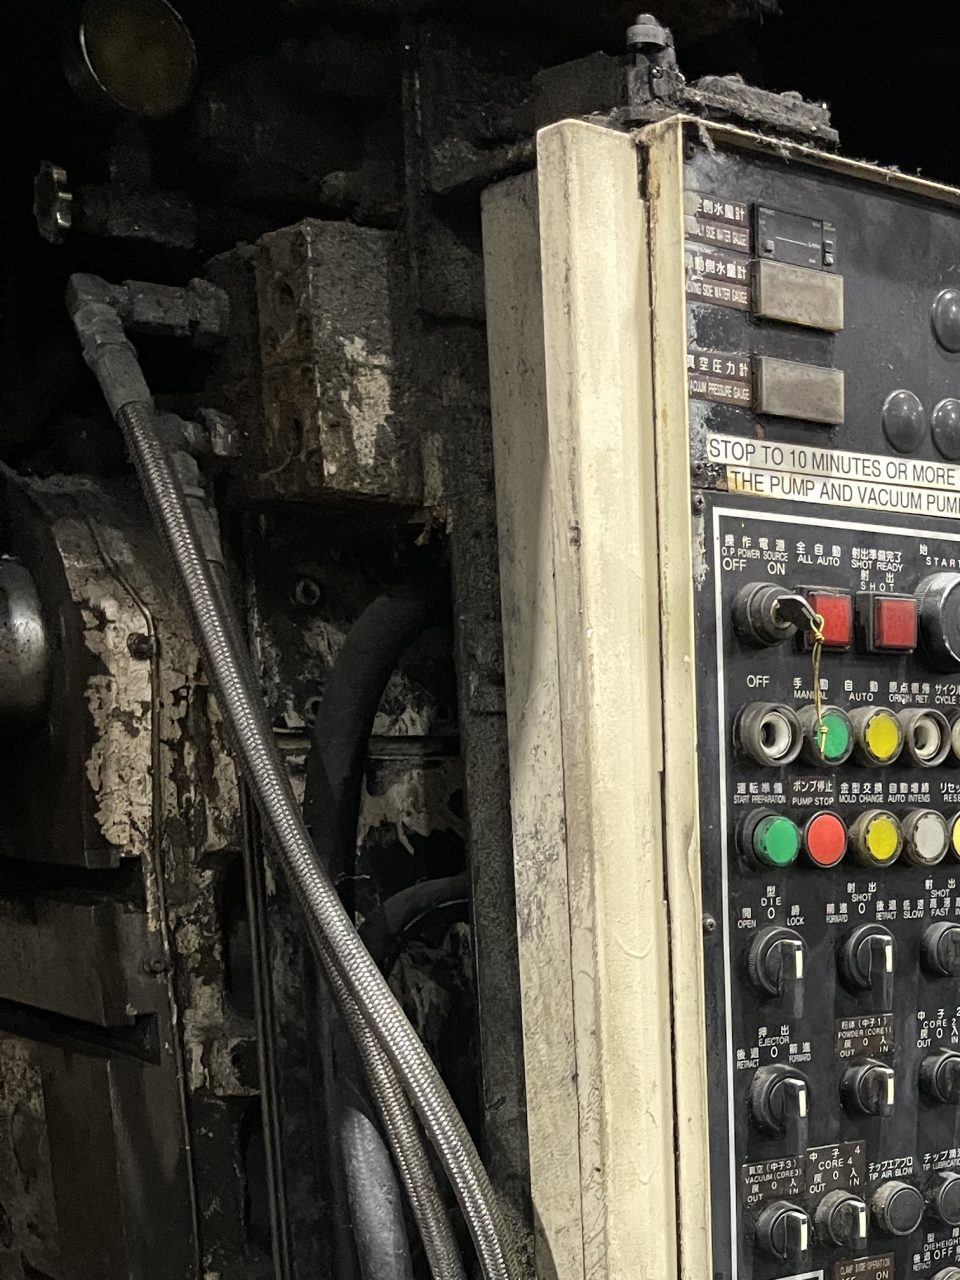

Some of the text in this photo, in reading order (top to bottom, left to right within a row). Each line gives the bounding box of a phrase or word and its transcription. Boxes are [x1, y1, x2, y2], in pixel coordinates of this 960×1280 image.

[709, 438, 756, 461] STOP
[761, 445, 783, 465] TO
[790, 450, 807, 469] 10
[811, 452, 882, 478] MINUTES
[886, 462, 907, 480] OR
[912, 465, 956, 486] MORE
[730, 471, 765, 492] THE
[770, 476, 815, 499] PUMP
[820, 482, 852, 502] AND
[857, 486, 922, 510] VACUUM
[738, 549, 788, 562] POWER SOURCE
[797, 554, 840, 566] ALL AUTO
[722, 557, 747, 571] OFF
[767, 561, 786, 575] ON
[851, 560, 903, 572] SHOT READY
[860, 581, 895, 592] SHOT
[746, 674, 770, 688] OFF
[793, 690, 828, 700] MANAL
[848, 692, 874, 702] AUTO
[935, 695, 956, 704] CYCLE
[792, 797, 835, 806] PUMP STOP
[839, 794, 884, 803] MOLD CHANGE
[888, 794, 906, 803] AUTO
[851, 893, 872, 902] SHOT
[930, 889, 950, 898] SHOT
[760, 897, 782, 906] DIE
[903, 910, 924, 919] SLOW
[931, 908, 950, 916] FAST
[738, 920, 757, 929] OPEN
[786, 917, 805, 926] LOCK
[923, 1019, 948, 1029] CORE
[758, 1036, 790, 1047] EJECTOR
[916, 1039, 932, 1048] OUT
[951, 1036, 959, 1044] IN
[840, 1049, 856, 1058] OUT
[880, 1045, 889, 1053] IN
[818, 1158, 844, 1171] CORE
[881, 1170, 893, 1179] AIR
[895, 1167, 913, 1177] BLOW
[849, 1177, 860, 1186] IN
[809, 1183, 826, 1194] OUT
[747, 1193, 764, 1203] OUT
[933, 1246, 953, 1260] OFF
[875, 1270, 889, 1280] ON
